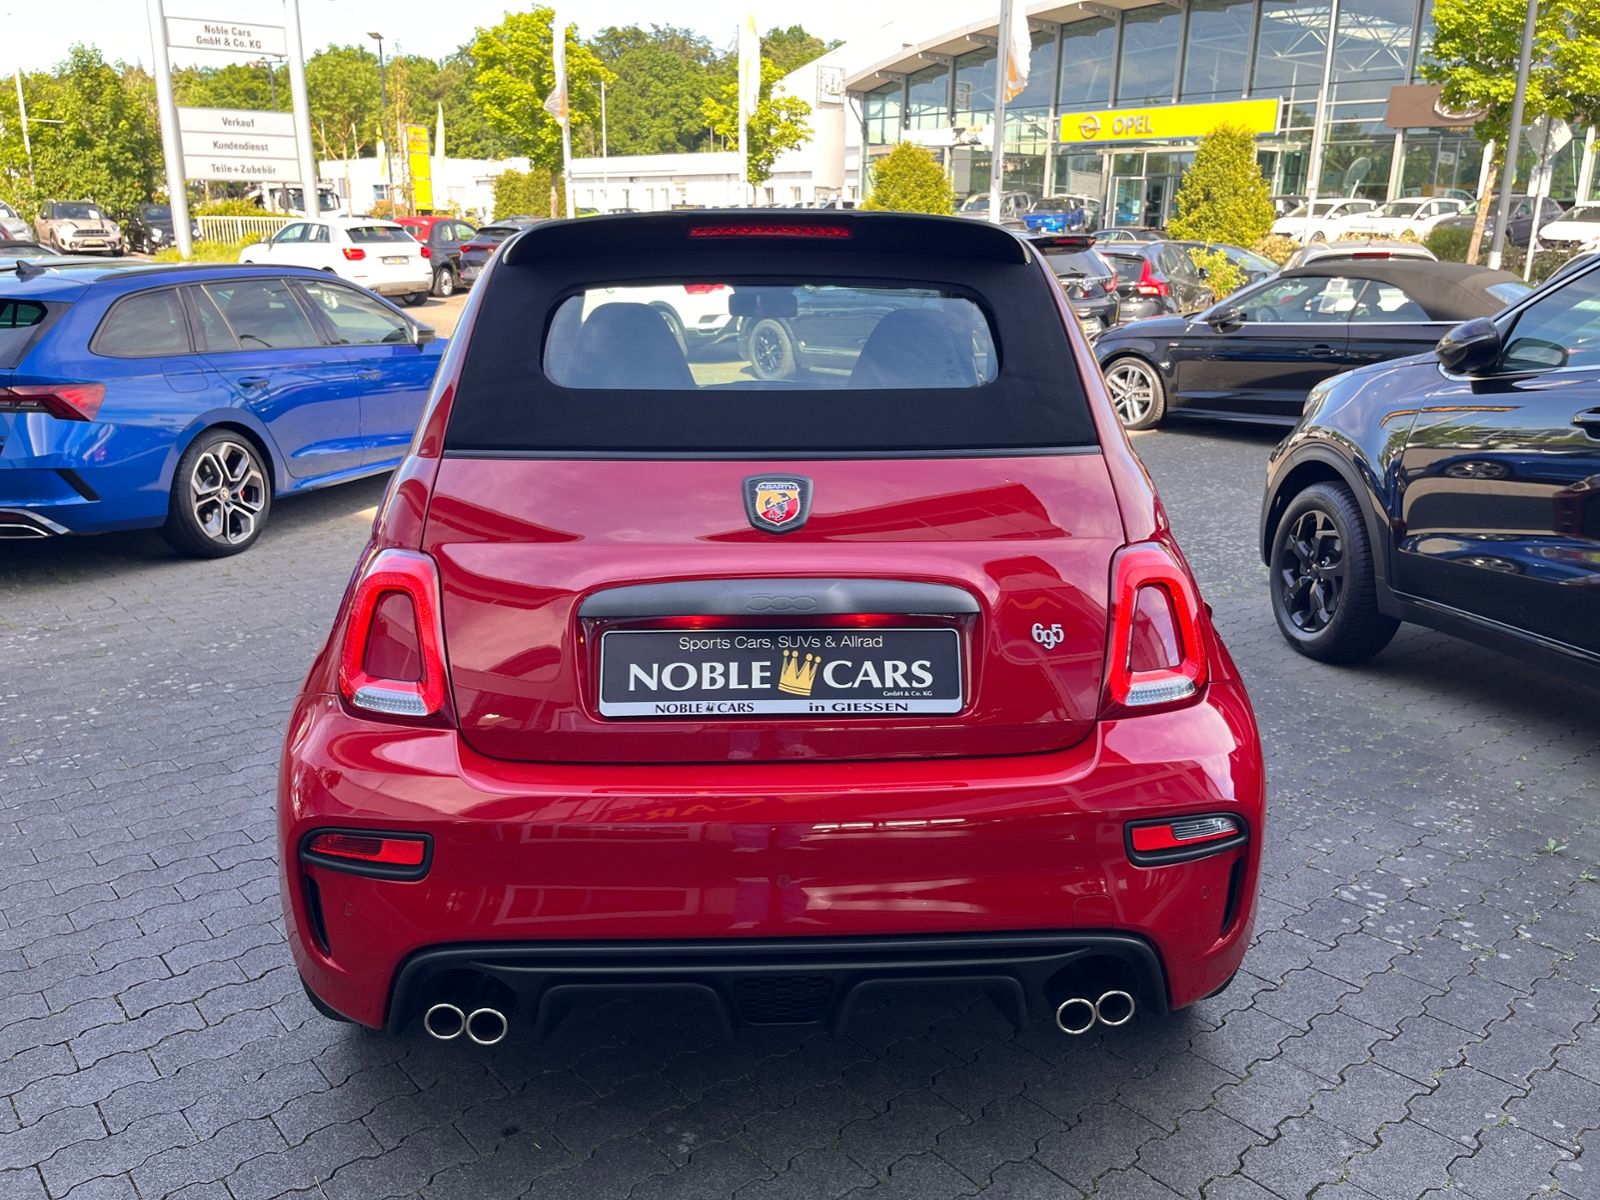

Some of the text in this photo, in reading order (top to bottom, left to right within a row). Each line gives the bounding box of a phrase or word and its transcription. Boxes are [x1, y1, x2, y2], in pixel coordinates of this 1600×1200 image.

[204, 24, 252, 37] Noble Cars
[196, 35, 262, 49] GmbH & Co. KG
[221, 117, 255, 128] Verkauf
[1112, 115, 1153, 136] OPEL
[212, 140, 269, 151] Kundendienst
[1031, 622, 1065, 650] 695
[678, 635, 883, 652] Sports Cars, SUVs & Allrad
[628, 660, 934, 691] NOBLE CARS
[655, 702, 908, 714] NOBLE CARS in GIESSEN
